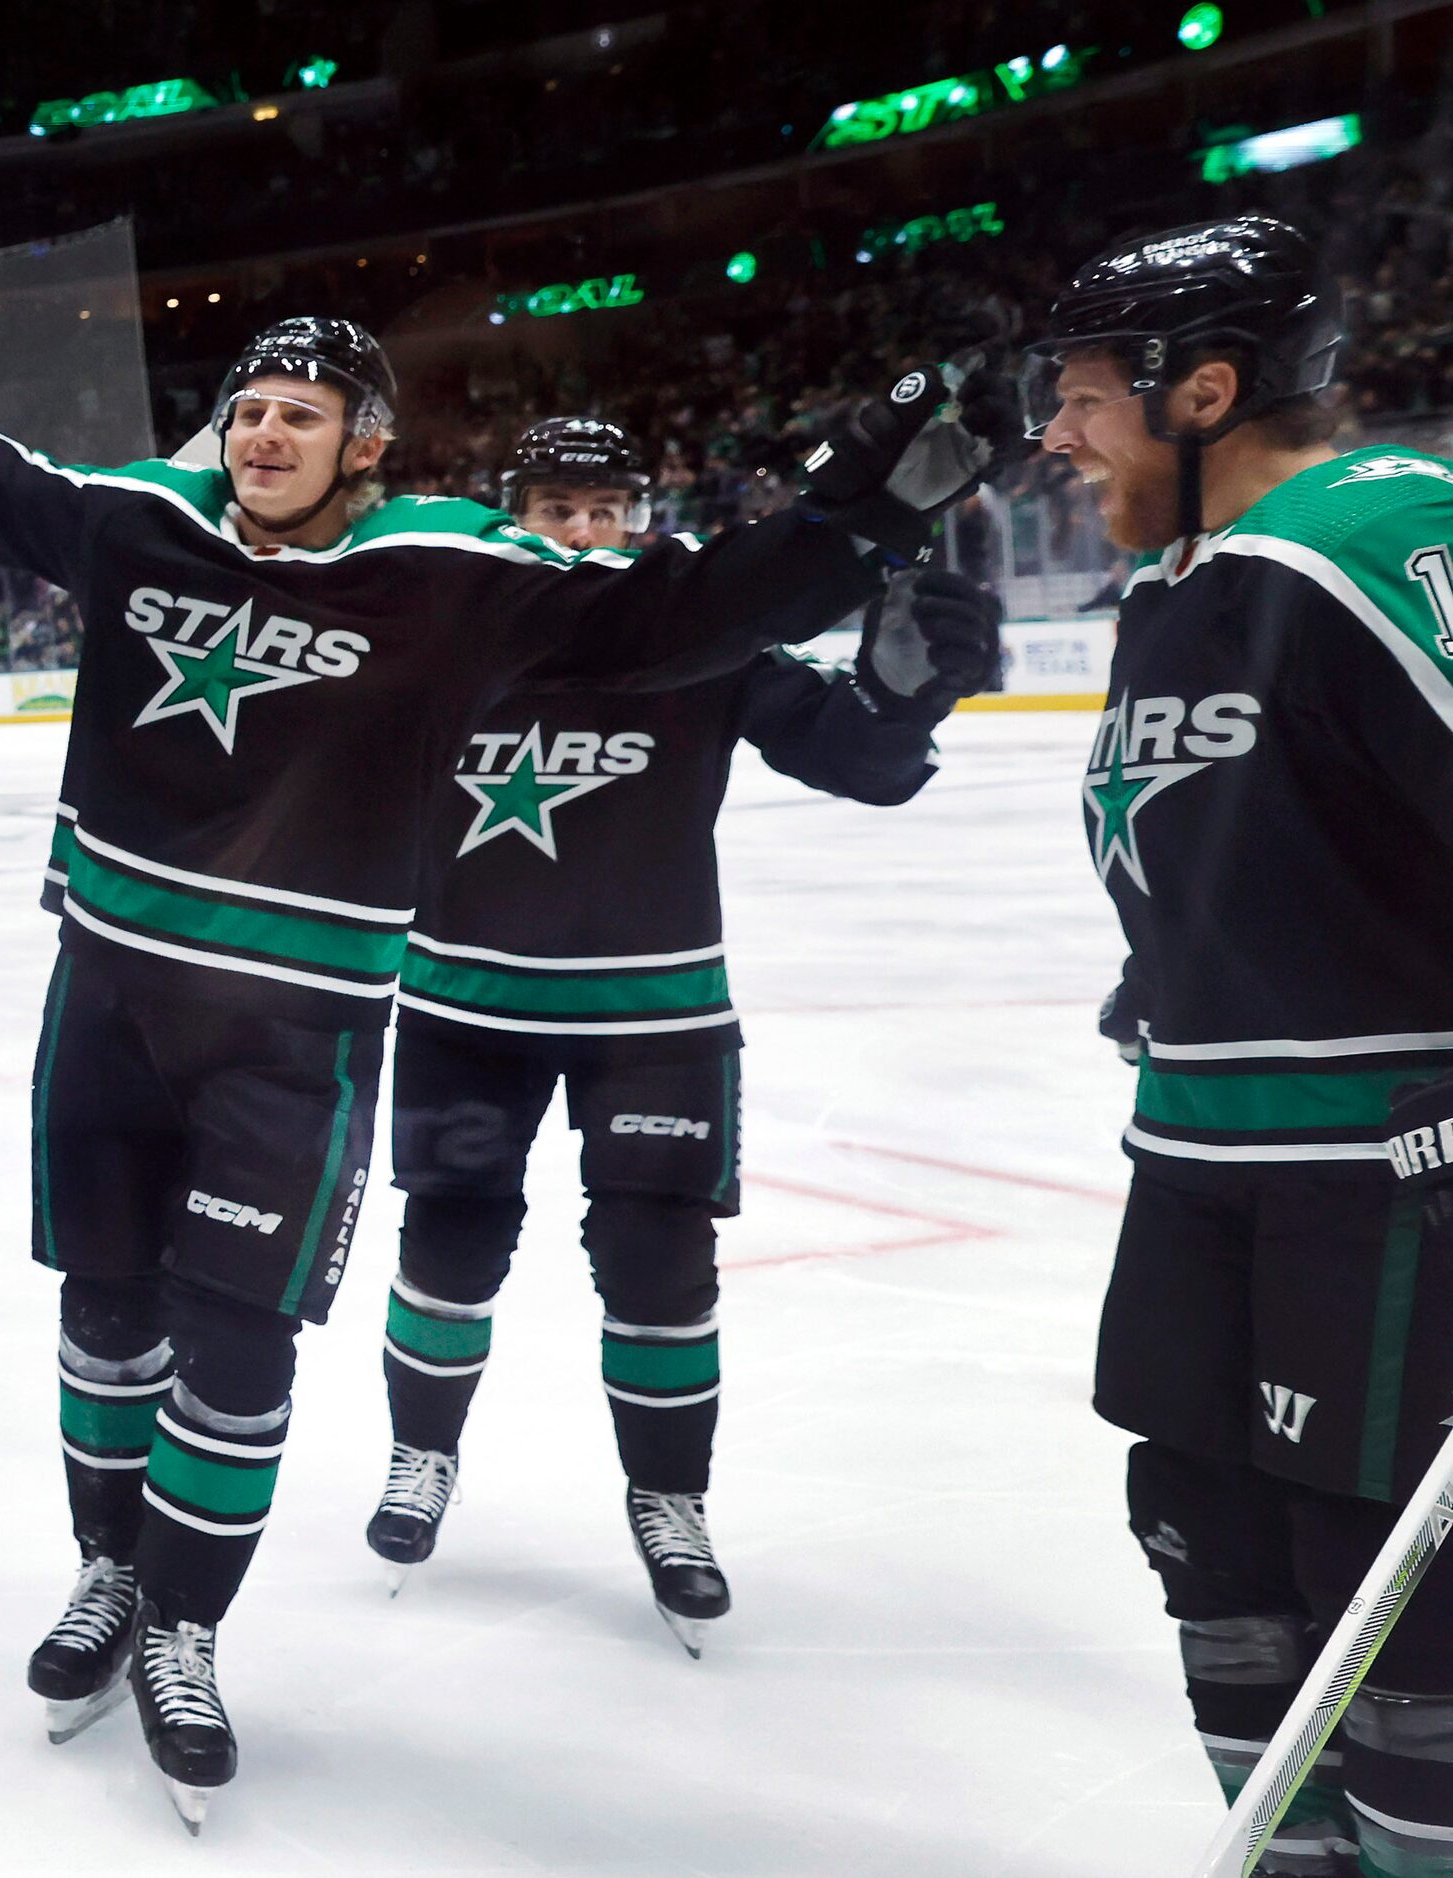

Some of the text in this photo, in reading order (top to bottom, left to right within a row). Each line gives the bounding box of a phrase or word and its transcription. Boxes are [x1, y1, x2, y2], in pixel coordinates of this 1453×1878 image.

[125, 587, 371, 678] STARS
[456, 721, 656, 775] TARS
[1090, 686, 1262, 769] TARS
[609, 1113, 711, 1140] CCM
[187, 1189, 284, 1235] CCM
[324, 1168, 367, 1285] DALLAS
